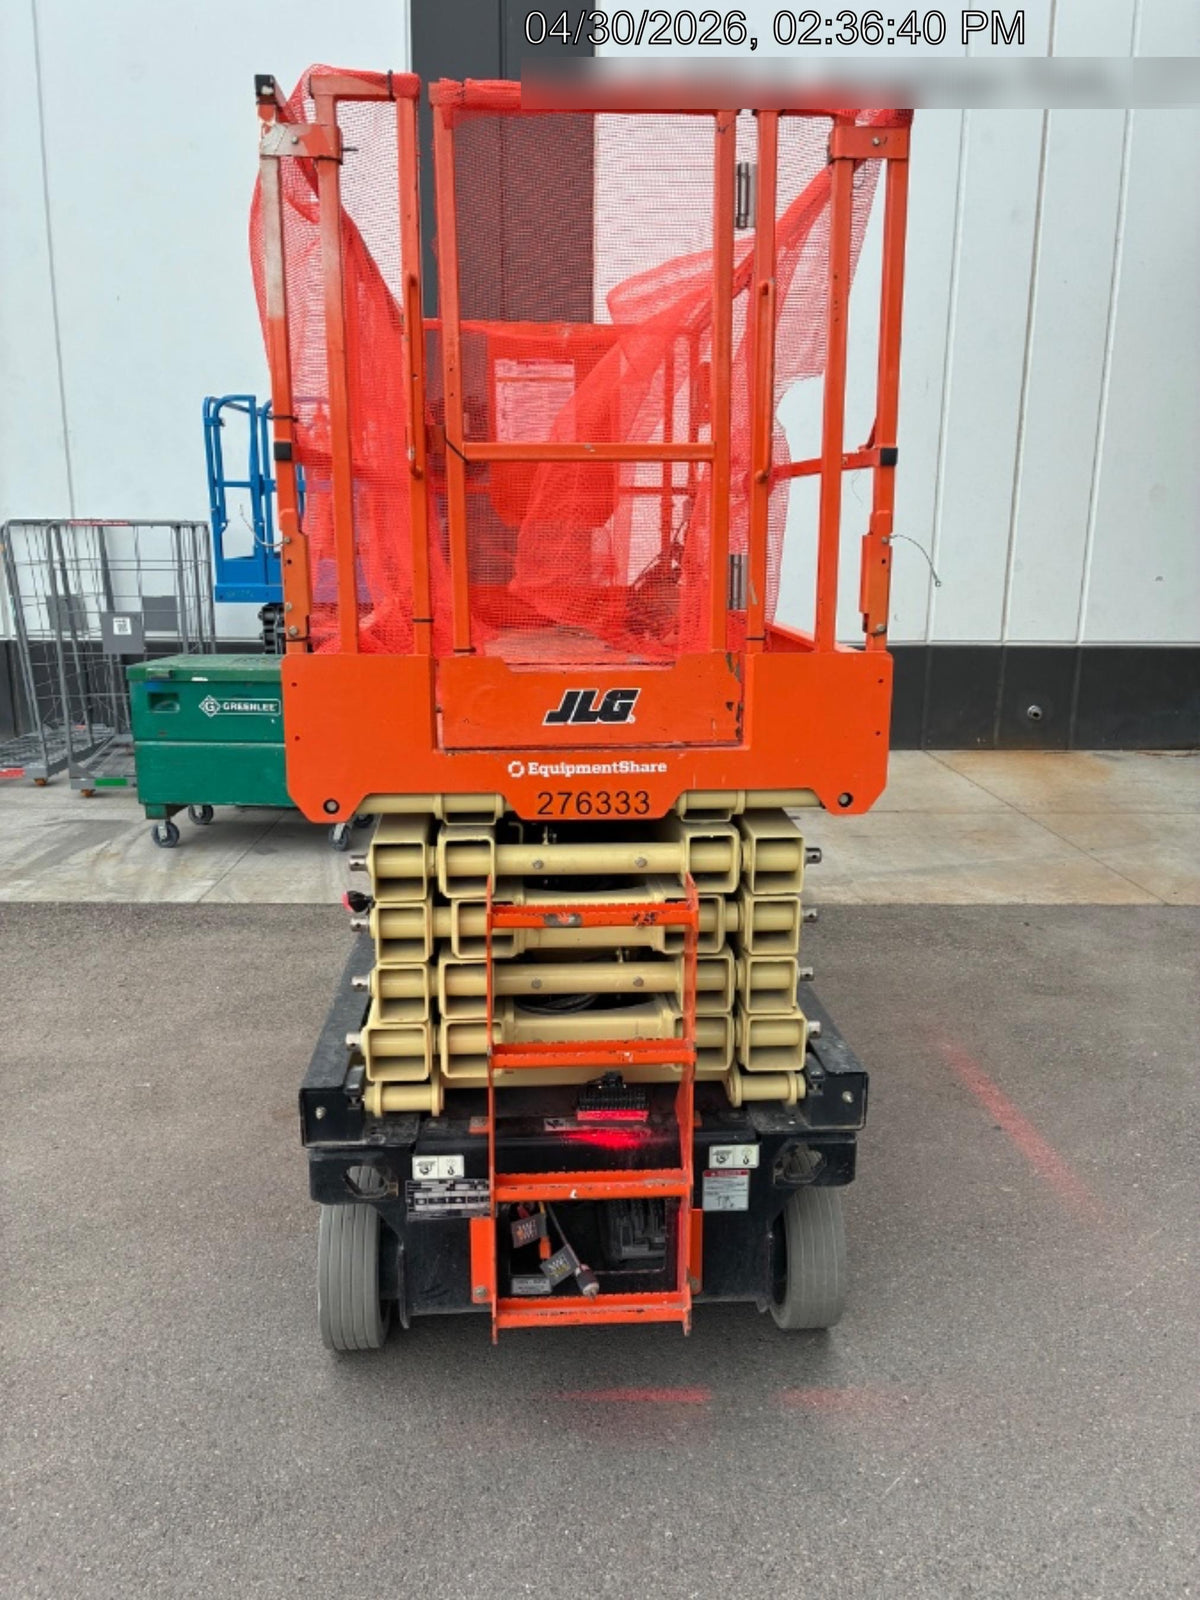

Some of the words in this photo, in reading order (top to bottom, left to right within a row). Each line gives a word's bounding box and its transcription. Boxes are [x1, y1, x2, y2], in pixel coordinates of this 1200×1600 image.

[542, 687, 641, 726] JLG
[528, 762, 667, 777] EquipmentShare
[537, 790, 650, 815] 276333
